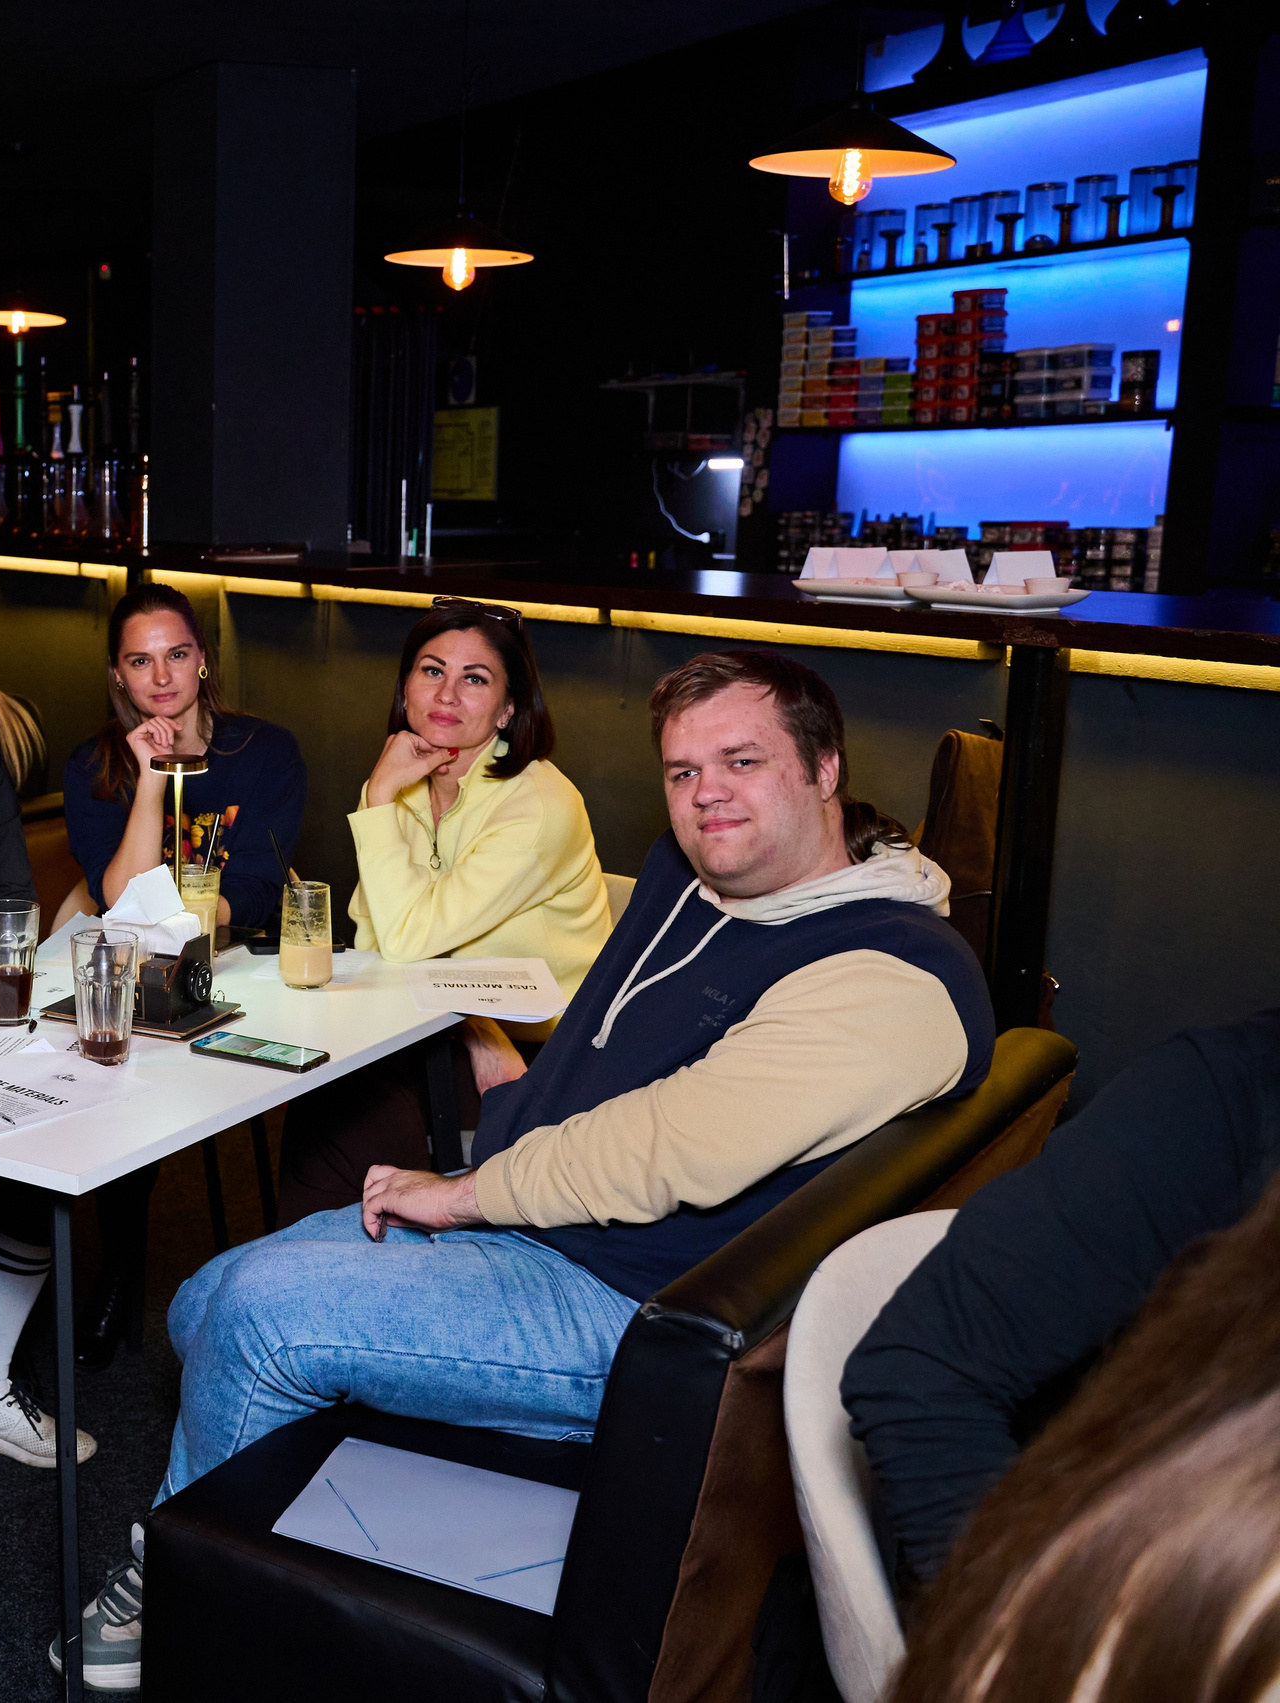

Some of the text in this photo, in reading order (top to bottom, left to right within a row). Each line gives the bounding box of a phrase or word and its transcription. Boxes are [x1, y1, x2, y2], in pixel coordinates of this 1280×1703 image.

[432, 982, 538, 991] CASE MATERIALS
[4, 1084, 69, 1106] MATERIALS
